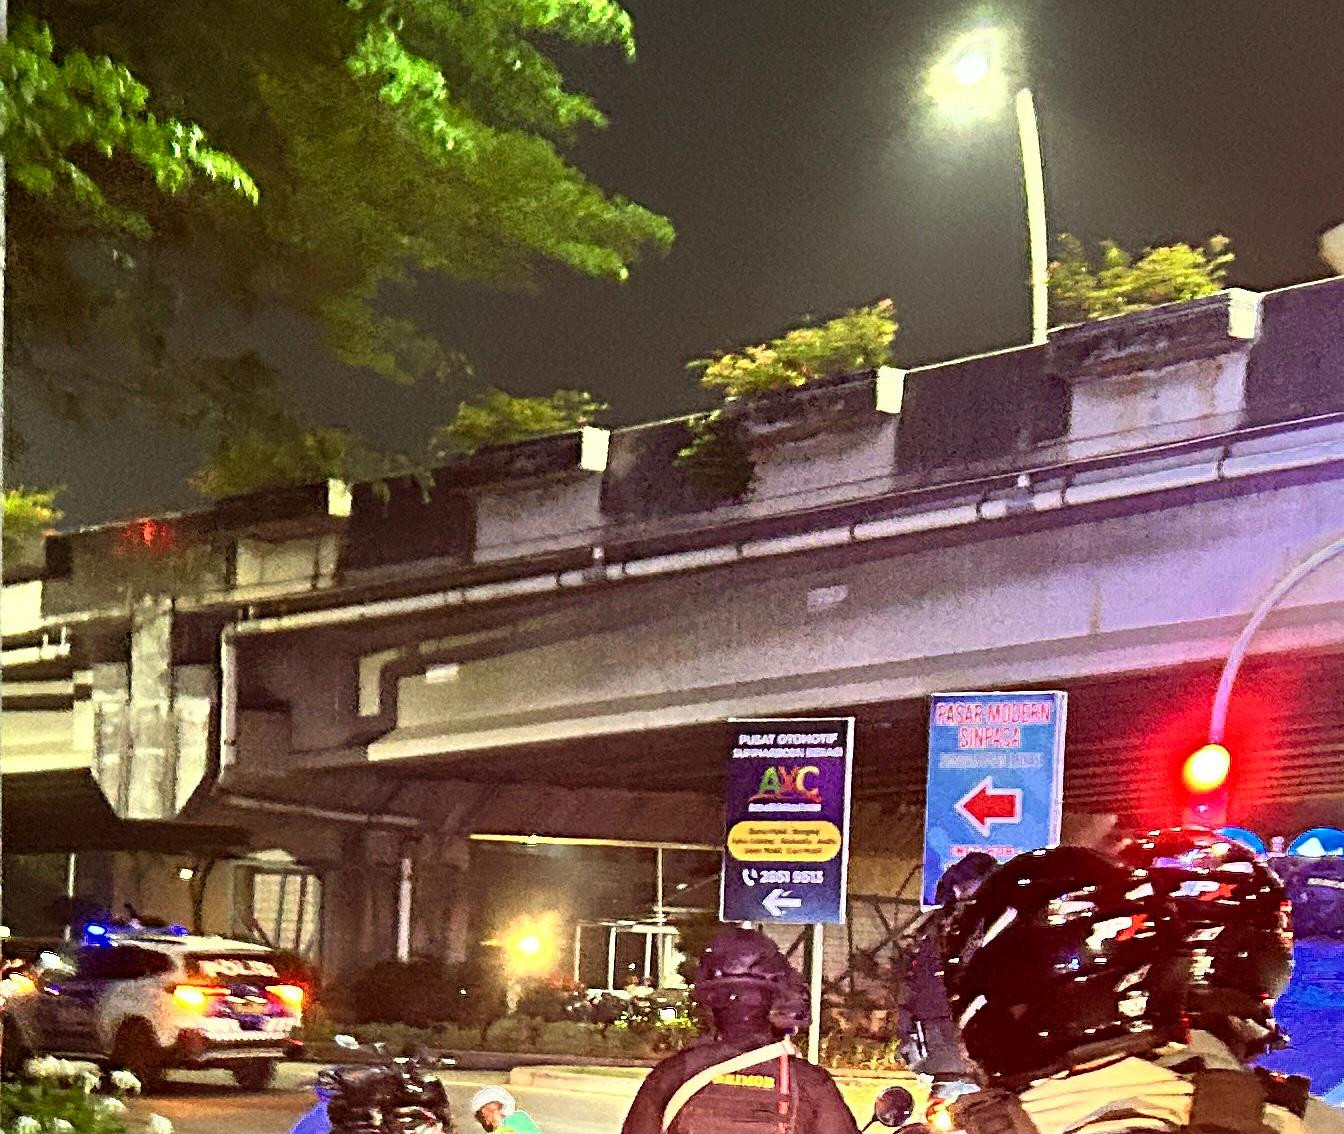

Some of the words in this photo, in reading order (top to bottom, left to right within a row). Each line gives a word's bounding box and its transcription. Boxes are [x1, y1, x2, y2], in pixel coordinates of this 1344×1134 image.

[937, 703, 983, 723] PASAR
[986, 702, 1051, 722] MODERN
[738, 734, 775, 745] PUSAT
[776, 733, 838, 745] OTOMOTIF
